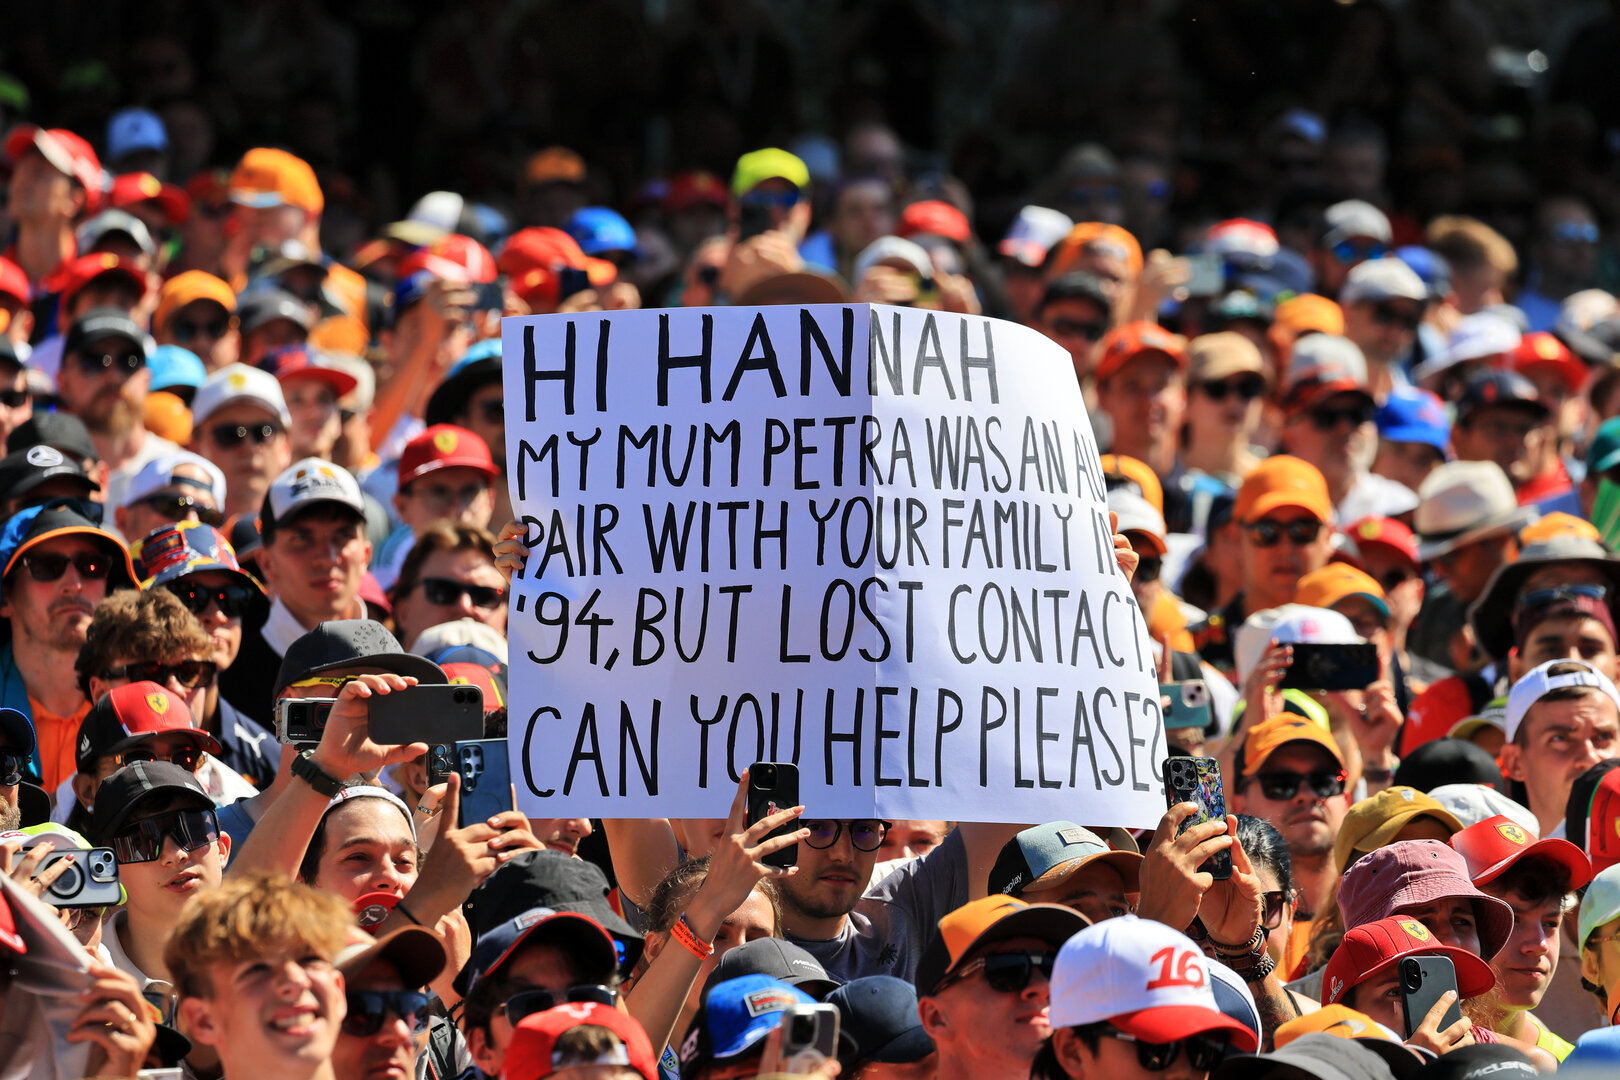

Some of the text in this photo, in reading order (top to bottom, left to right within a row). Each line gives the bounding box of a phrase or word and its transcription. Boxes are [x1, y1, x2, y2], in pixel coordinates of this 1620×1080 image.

[523, 307, 1000, 422] HI HANNAH
[517, 427, 601, 500] MY
[616, 419, 741, 489] MUM
[763, 415, 916, 490] PETRA
[925, 415, 1011, 493] WAS
[1019, 416, 1068, 494] AN
[517, 503, 624, 580] PAIR
[642, 499, 789, 573] WITH
[809, 496, 930, 570] YOUR
[942, 498, 1073, 572] FAMILY
[632, 583, 753, 667] BUT
[779, 577, 924, 664] LOST
[948, 581, 1157, 679] CONTACT.
[521, 685, 1166, 798] CAN YOU HELP PLEASE?
[1146, 946, 1205, 992] 16
